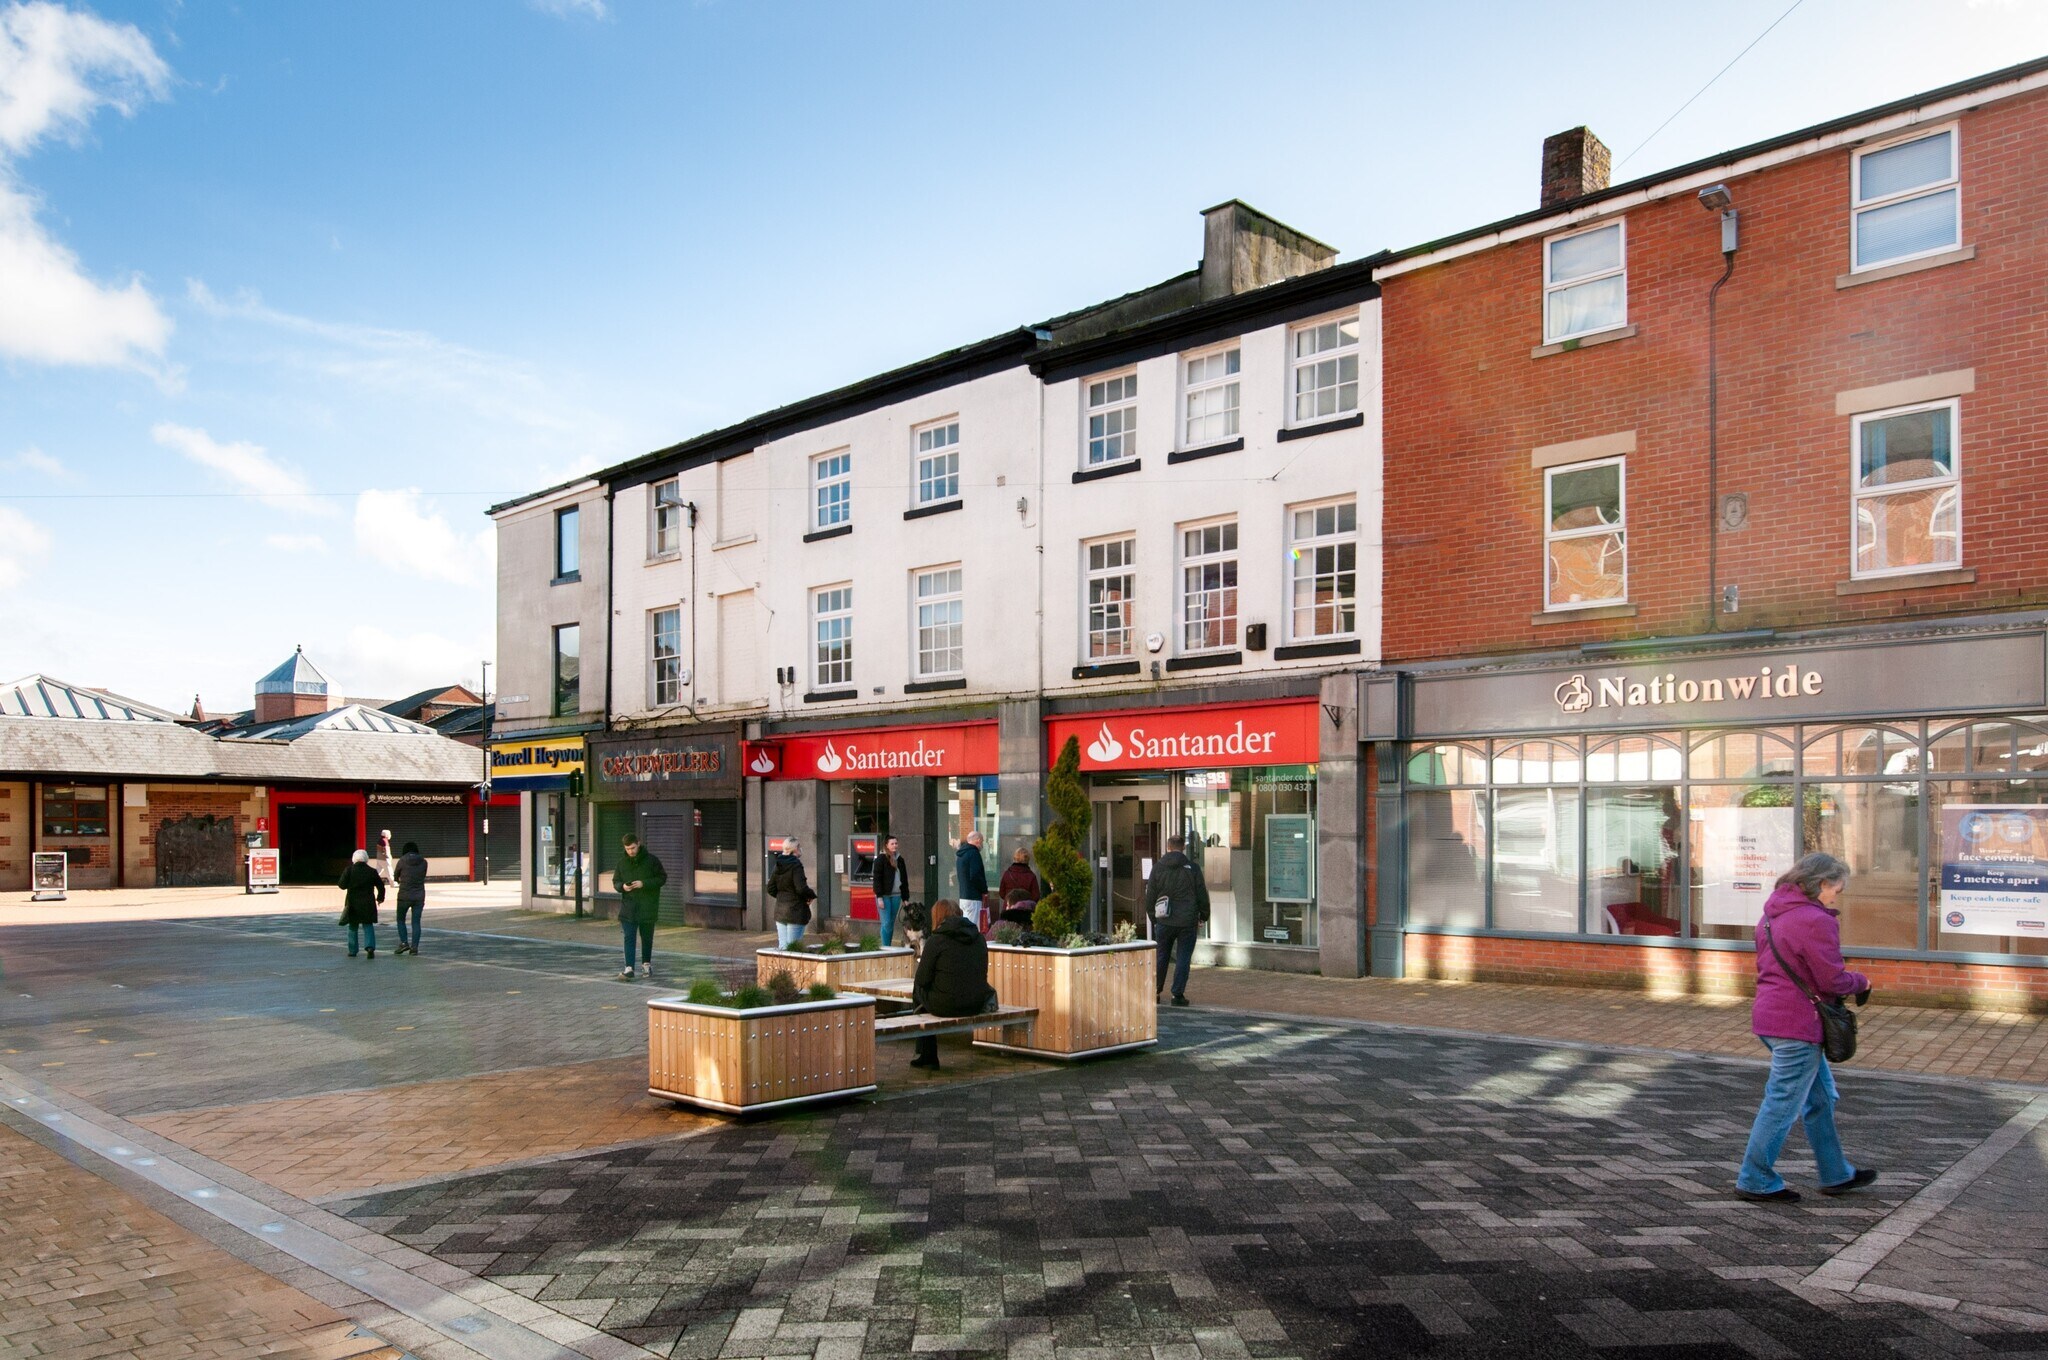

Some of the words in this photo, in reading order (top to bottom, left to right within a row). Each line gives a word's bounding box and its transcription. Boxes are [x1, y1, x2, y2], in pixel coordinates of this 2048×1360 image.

[1598, 665, 1824, 709] Nationwide
[1129, 720, 1276, 758] Santander
[492, 747, 532, 766] Farrell
[602, 756, 635, 776] C&K
[635, 750, 721, 774] JEWELLERS
[846, 740, 944, 770] Santander
[1258, 783, 1277, 792] 0800
[1279, 783, 1293, 792] 030
[1958, 852, 1982, 861] face
[1984, 854, 2035, 864] covering
[1953, 873, 1961, 883] 2
[1964, 875, 2004, 884] metres
[2007, 876, 2039, 886] apart
[1987, 869, 2005, 877] Keep
[1950, 894, 1972, 902] Keep
[1974, 894, 1994, 902] each
[1996, 895, 2021, 903] other
[2023, 896, 2042, 904] safe
